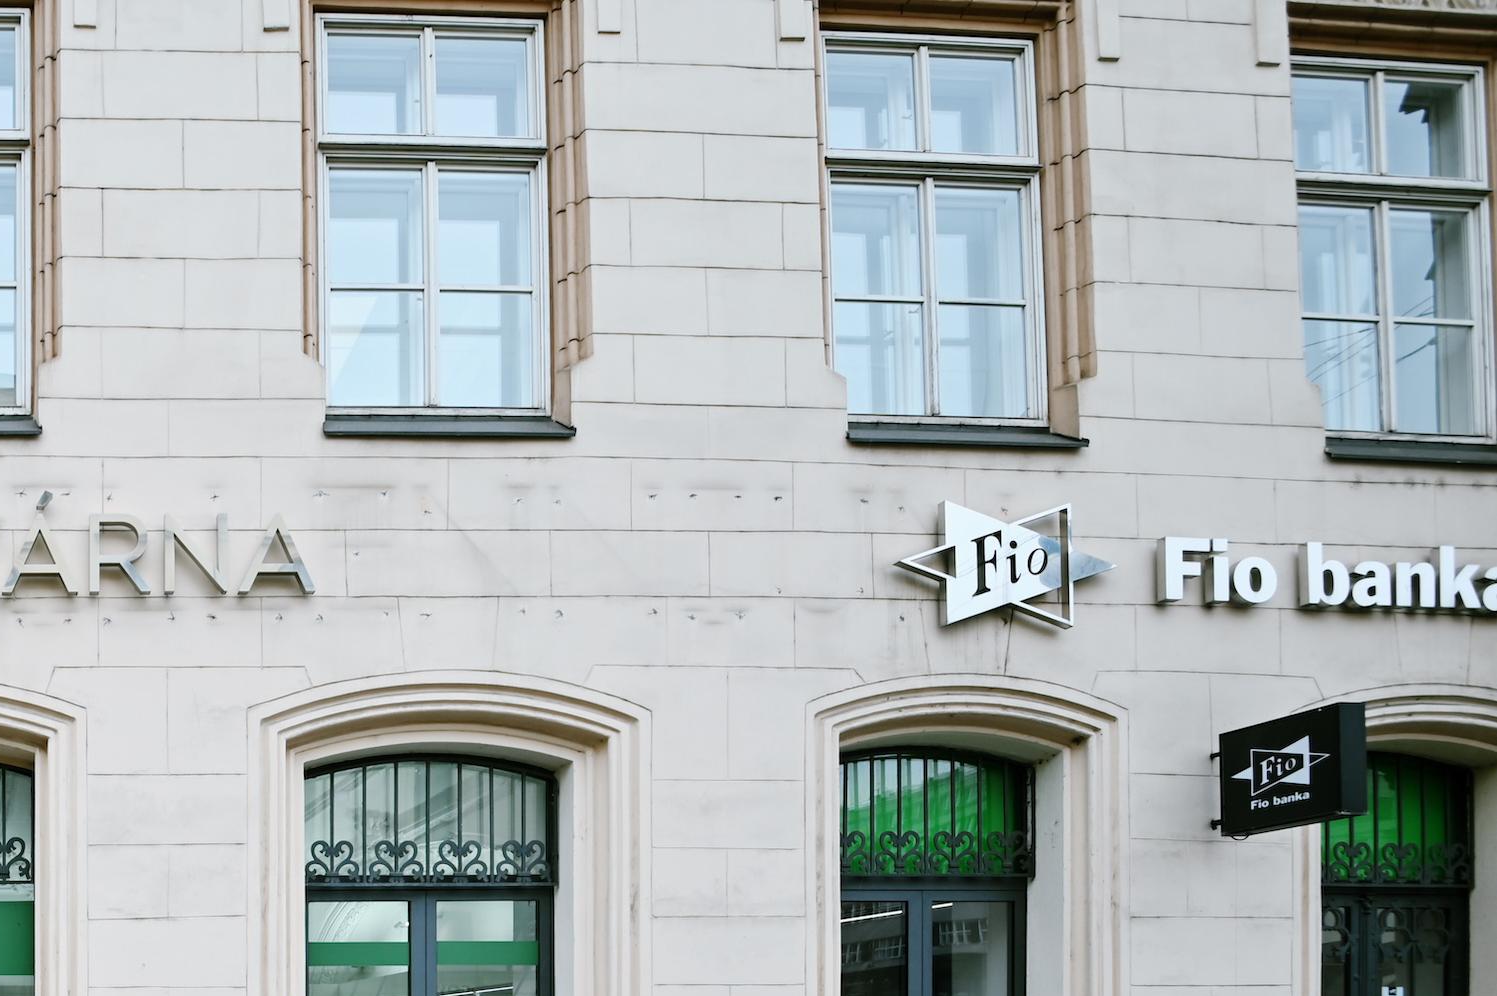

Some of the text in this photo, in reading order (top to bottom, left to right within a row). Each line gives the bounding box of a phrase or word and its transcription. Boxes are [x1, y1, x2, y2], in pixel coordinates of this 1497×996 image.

[970, 529, 1048, 598] Fio
[1157, 536, 1278, 603] Fio
[1259, 755, 1297, 786] Fio
[1250, 791, 1310, 811] Fio banka
